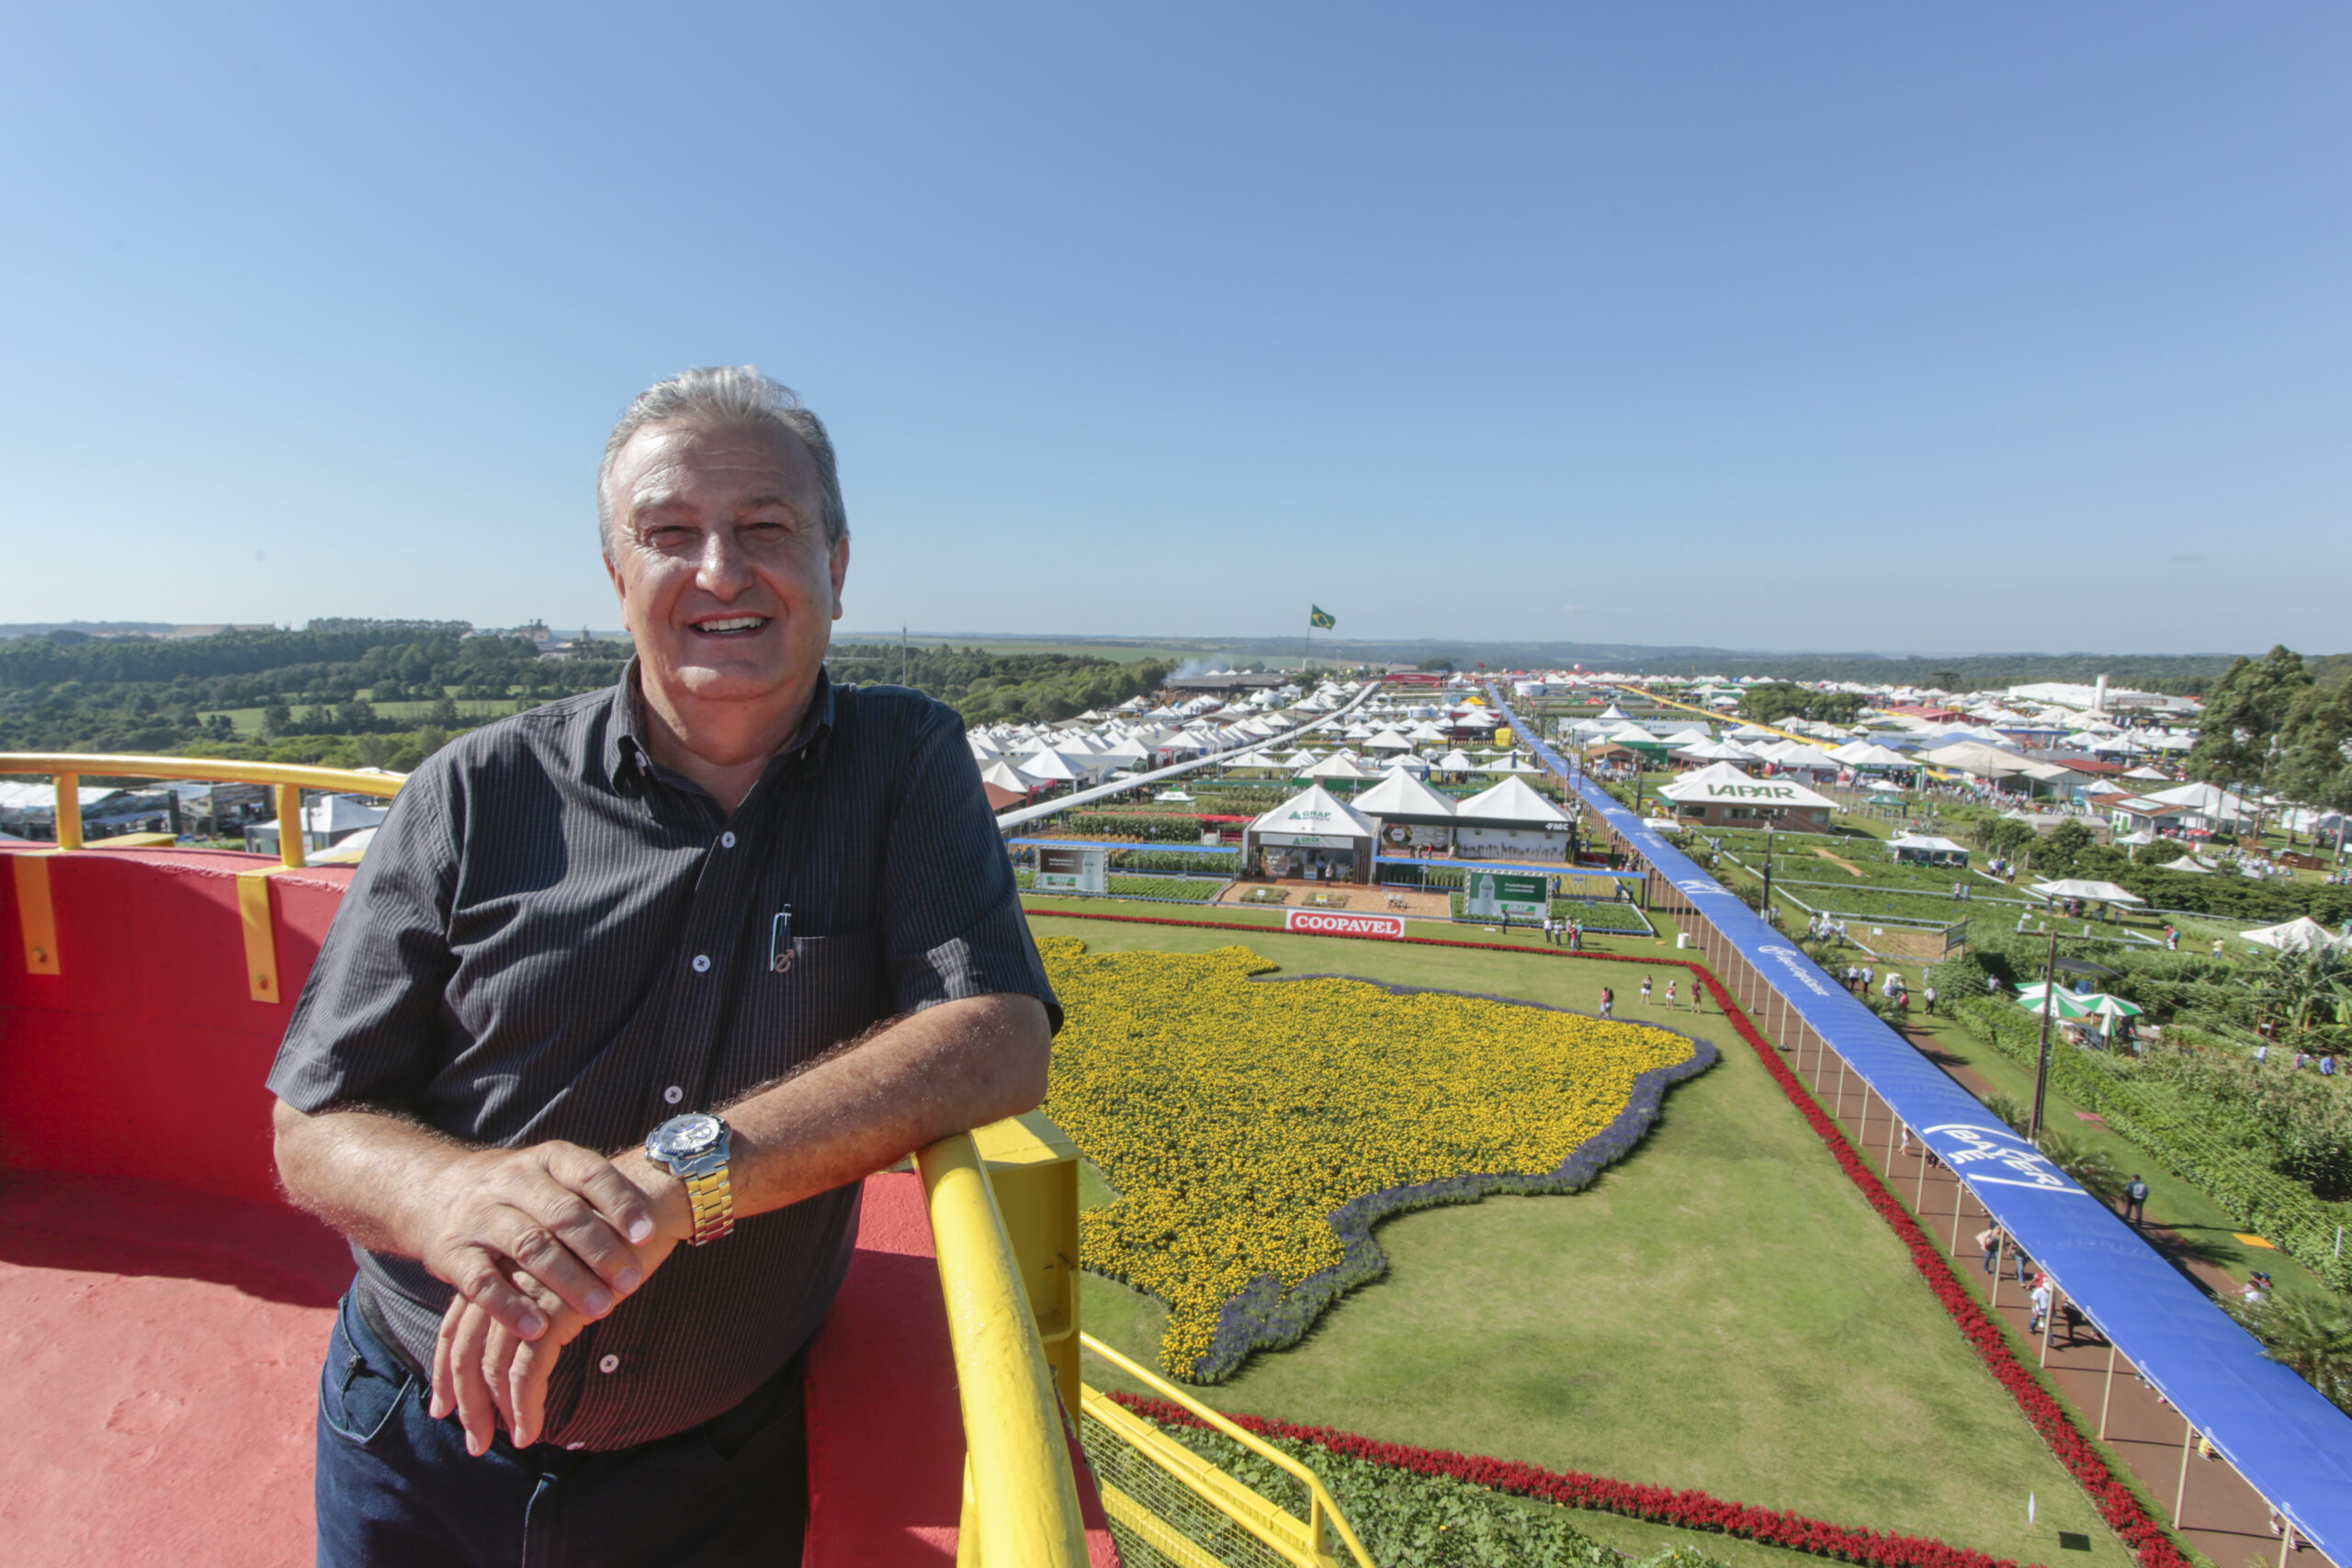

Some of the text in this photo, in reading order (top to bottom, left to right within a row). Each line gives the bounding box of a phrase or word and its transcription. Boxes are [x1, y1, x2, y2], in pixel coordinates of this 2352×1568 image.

[1707, 784, 1798, 799] IAPAR
[1545, 822, 1569, 830] FMC
[1295, 915, 1397, 934] COOPAVEL
[1943, 1130, 2064, 1186] BAYER
